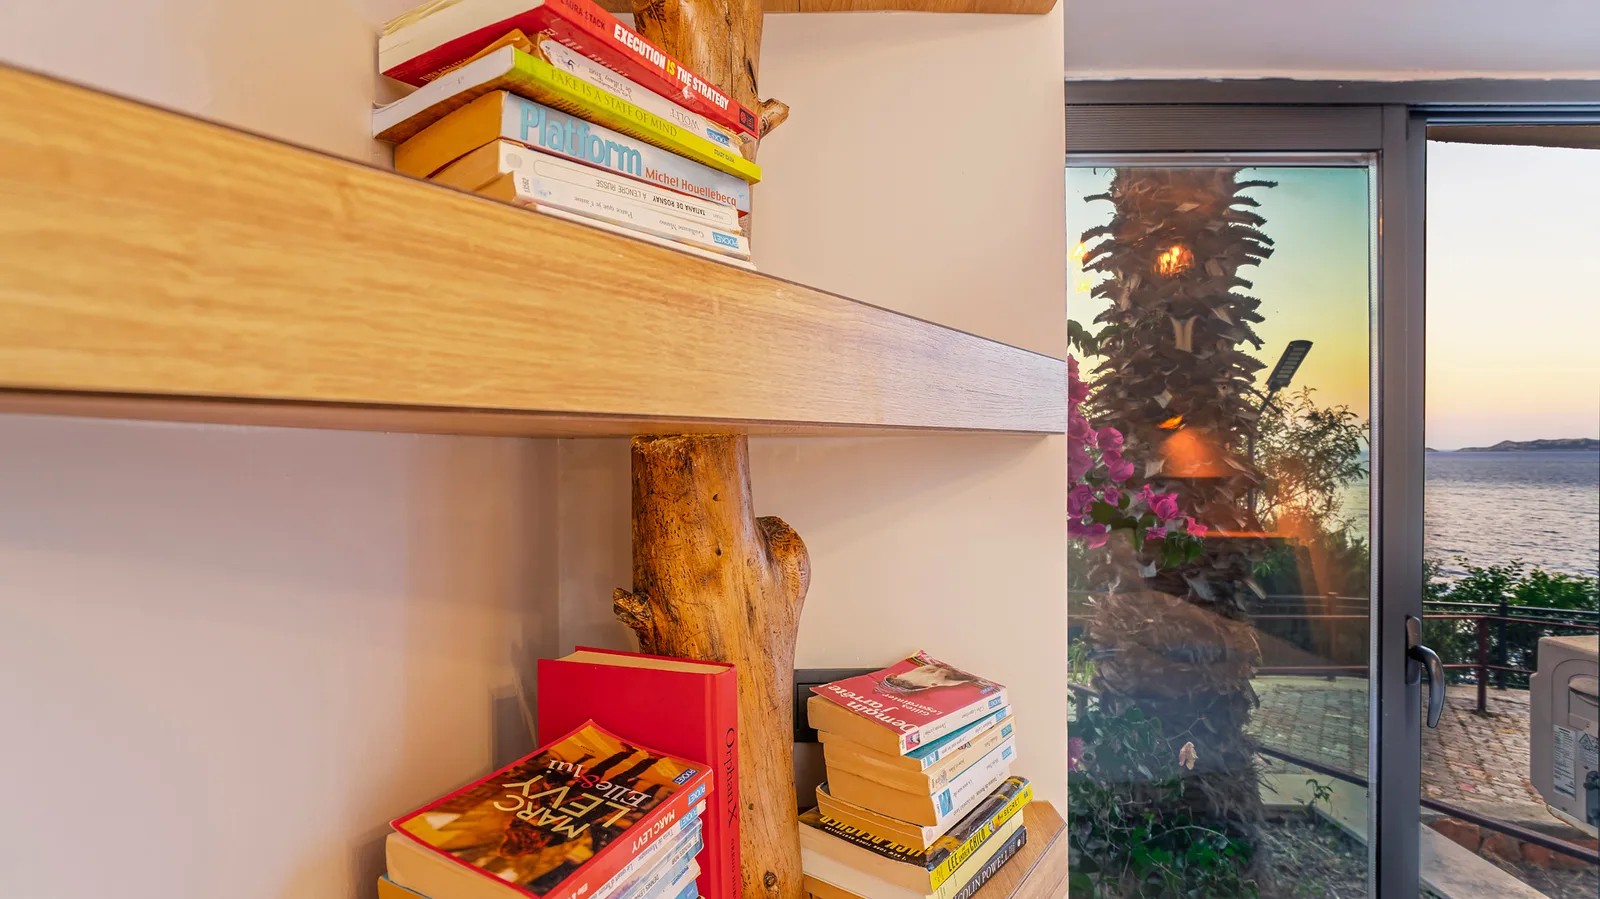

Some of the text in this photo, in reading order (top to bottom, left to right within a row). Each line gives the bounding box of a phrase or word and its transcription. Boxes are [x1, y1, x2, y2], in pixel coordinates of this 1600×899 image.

[585, 11, 605, 31] STACK
[614, 23, 667, 70] EXECUTION
[666, 59, 675, 76] IS
[677, 65, 692, 87] THE
[693, 77, 730, 111] STRATEGY
[551, 69, 678, 138] FAKE IS A STATE OF MIND
[519, 101, 642, 178] Platform
[596, 179, 616, 192] RUSSE
[645, 166, 737, 207] Michel Houellebecq
[652, 195, 675, 207] ROSNAY
[676, 202, 684, 210] DE
[685, 204, 706, 216] TATIANA
[713, 232, 738, 249] POCKET
[881, 692, 944, 716] Legardinier
[902, 704, 930, 716] Gilles
[847, 701, 920, 734] Demain
[546, 759, 585, 778] lui
[502, 774, 631, 828] LEVY
[596, 780, 652, 808] Elle
[493, 794, 591, 839] MARC
[728, 803, 738, 828] X
[1003, 798, 1020, 817] SECRET
[631, 809, 675, 854] MARC LEVY
[947, 852, 959, 872] LEE
[969, 828, 986, 852] CHILD
[981, 850, 1010, 883] POWELL
